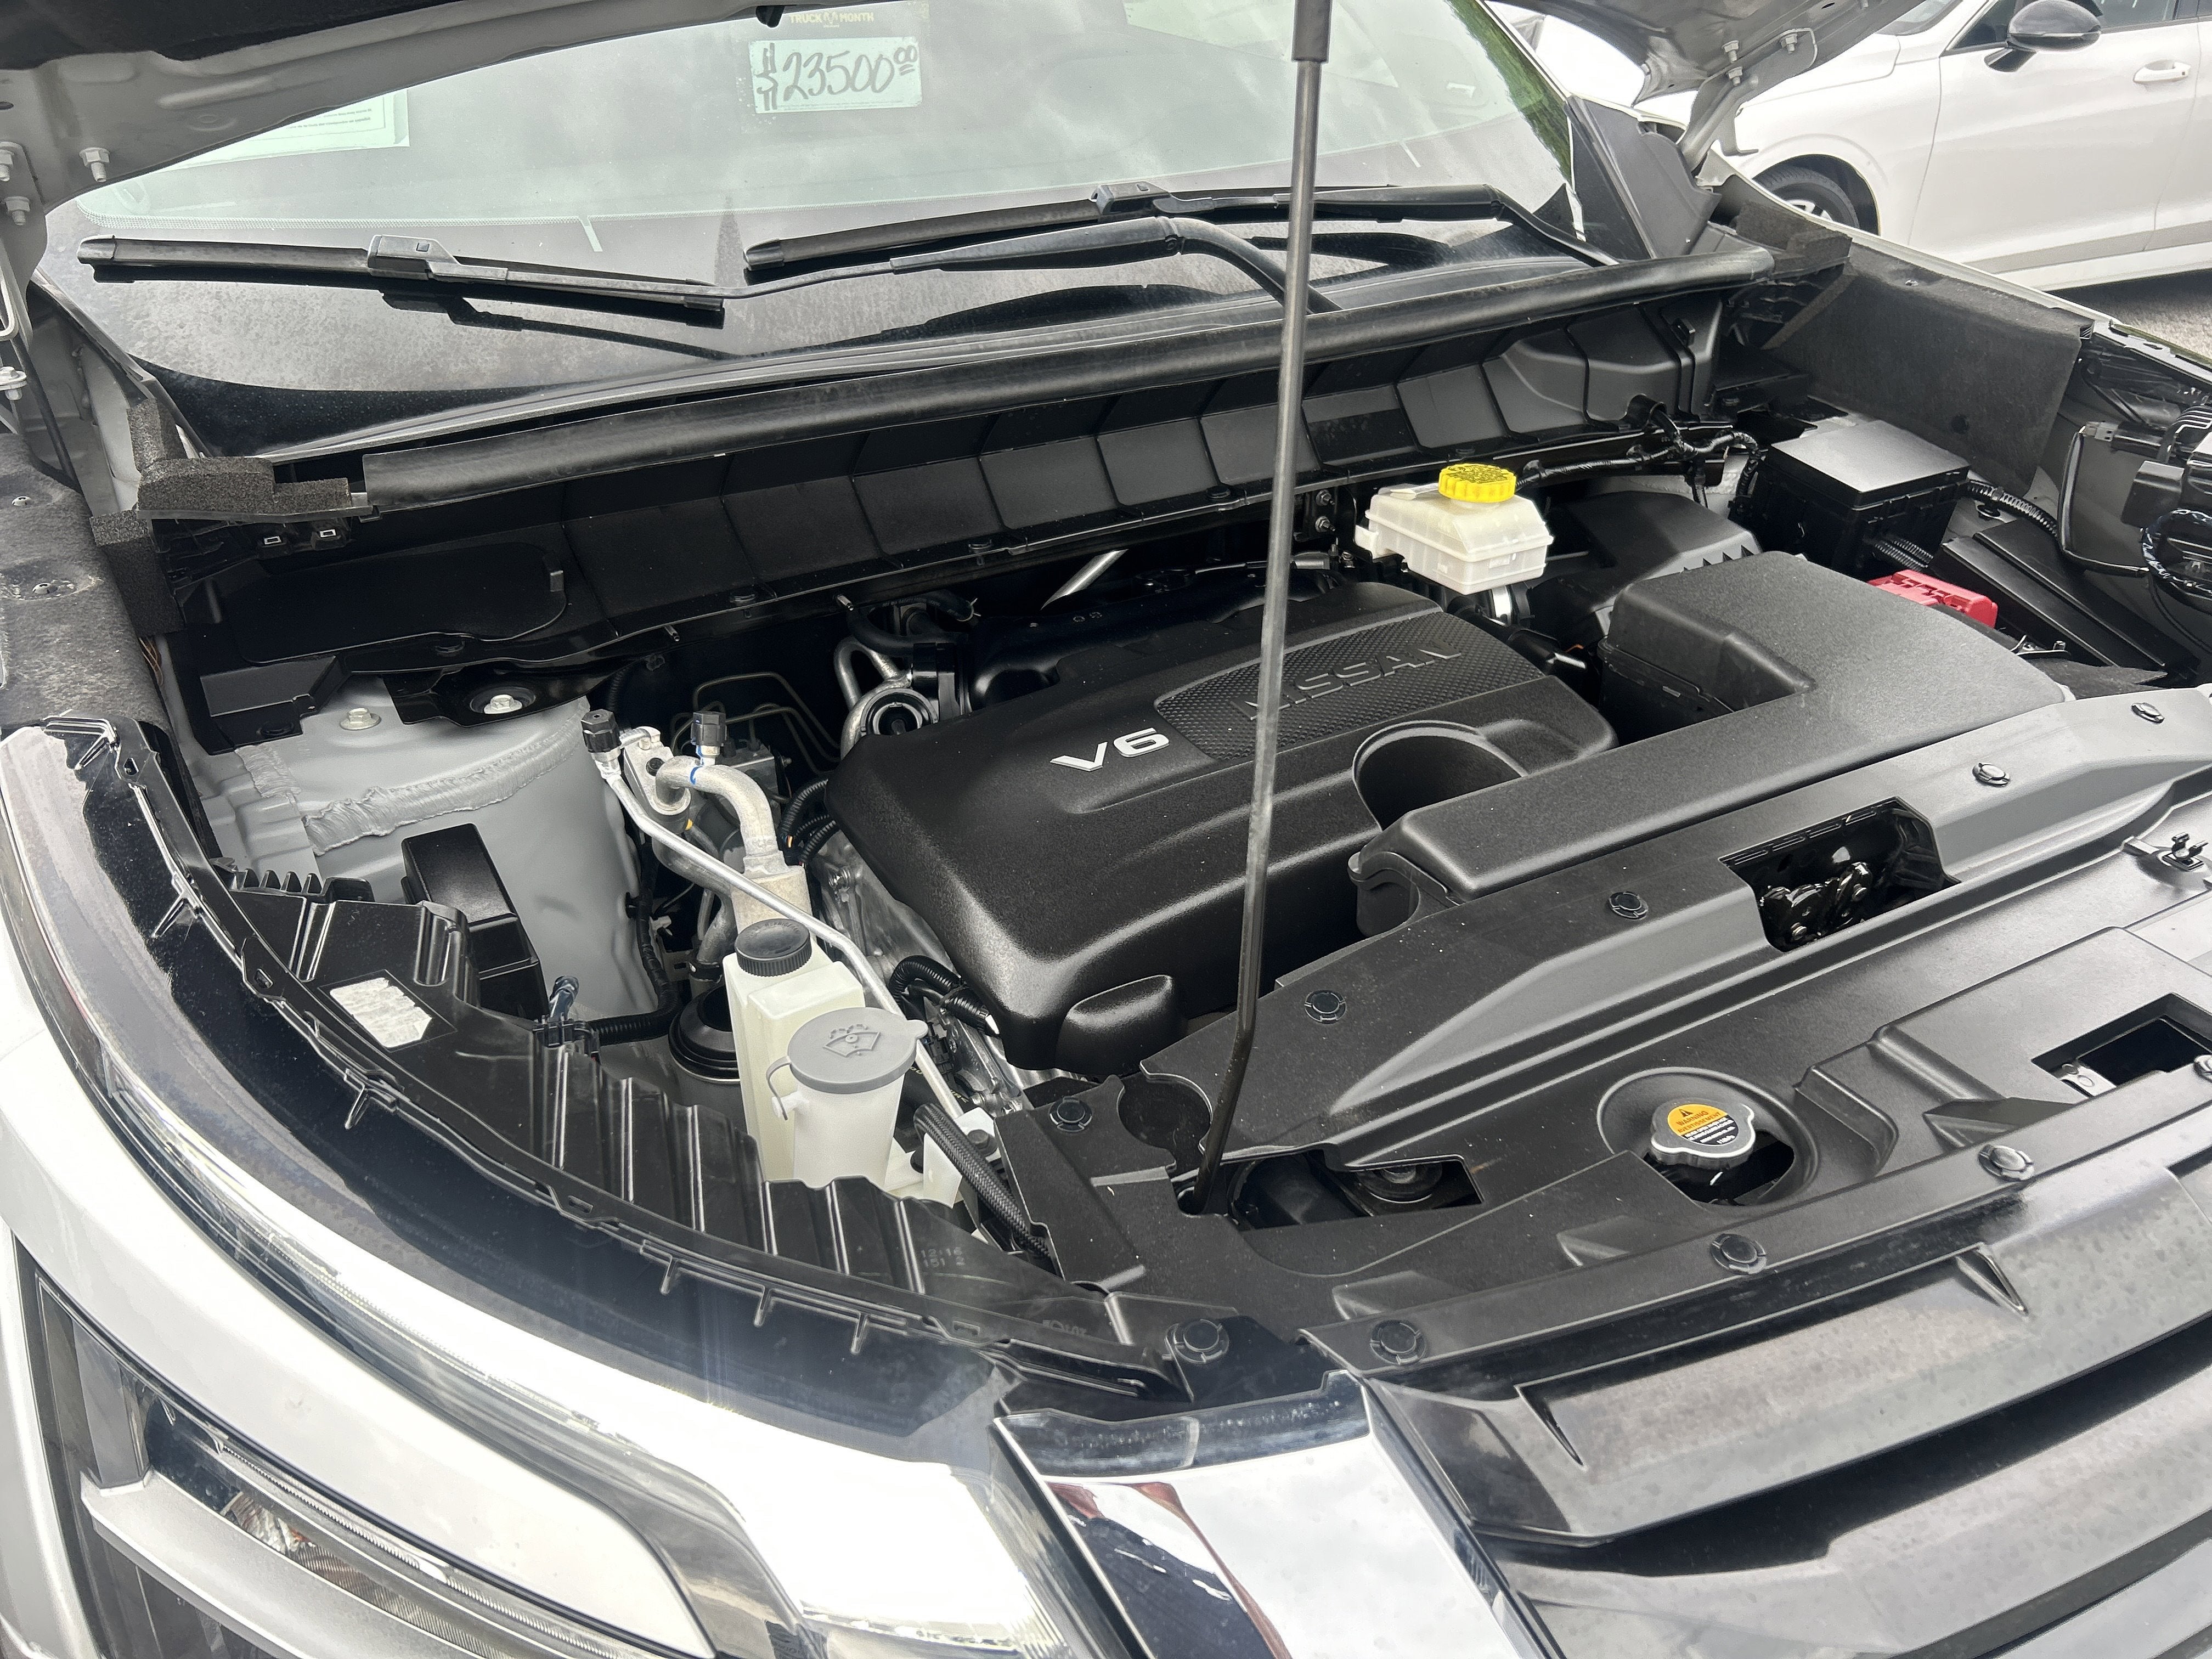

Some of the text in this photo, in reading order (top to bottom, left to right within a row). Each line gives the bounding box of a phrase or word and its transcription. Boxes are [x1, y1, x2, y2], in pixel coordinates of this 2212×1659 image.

[790, 12, 874, 24] TRUCK MONTH
[1049, 727, 1170, 772] V6
[1677, 1111, 1708, 1126] WARNING
